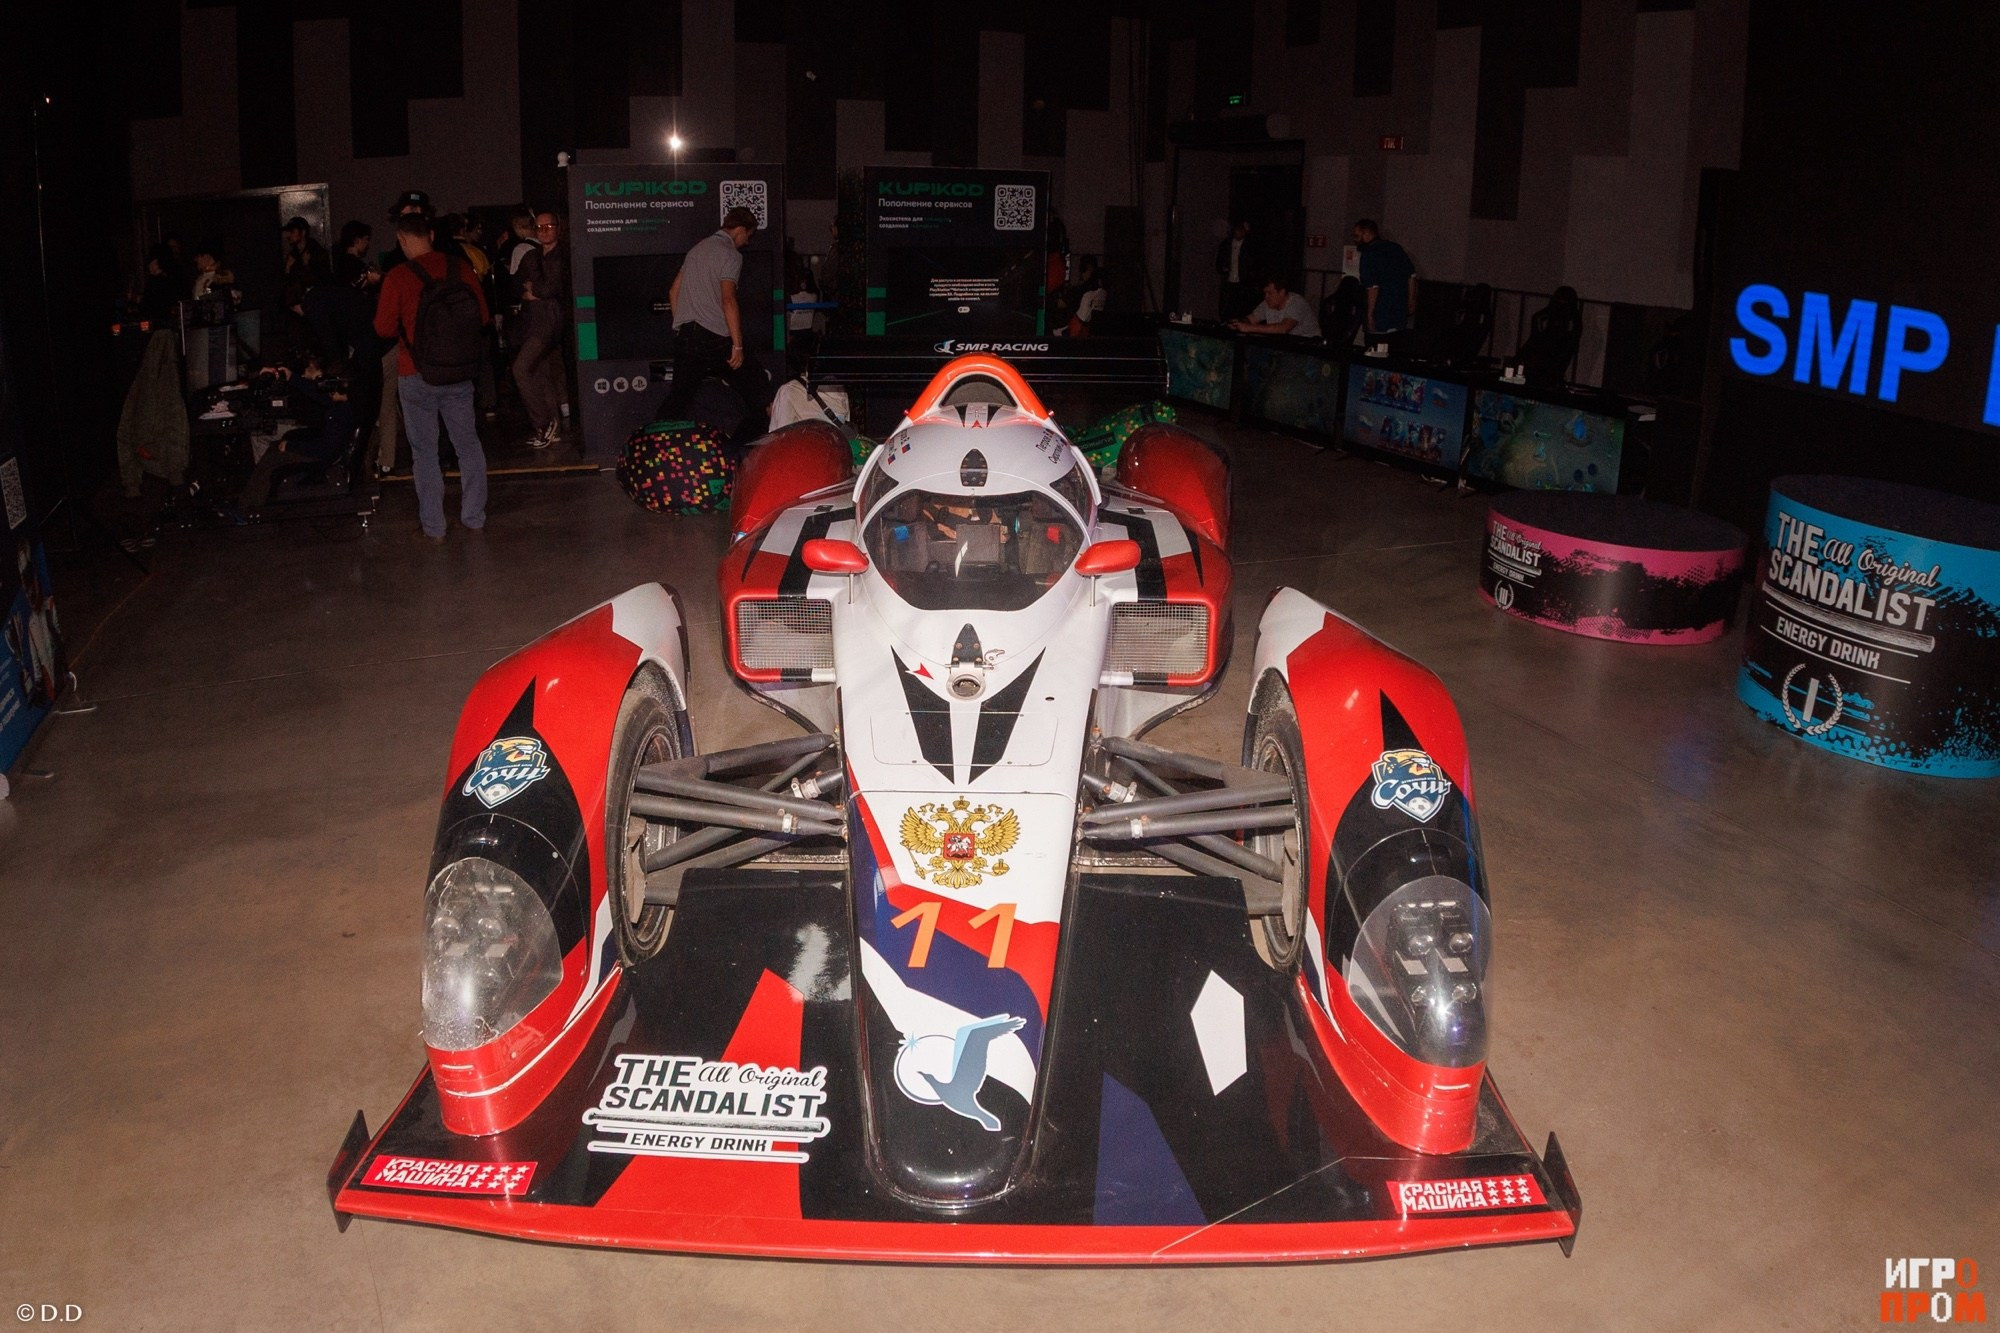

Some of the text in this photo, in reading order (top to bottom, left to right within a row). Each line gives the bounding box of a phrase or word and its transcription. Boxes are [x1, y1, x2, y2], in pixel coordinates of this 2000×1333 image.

[585, 179, 708, 196] KUPIKOD
[878, 181, 985, 197] KUPIKOD
[585, 199, 694, 210] Пополнение сервисов
[878, 198, 973, 209] Пополнение сервисов
[955, 343, 1049, 352] SMP RACING
[1730, 283, 1950, 403] SMP
[1493, 520, 1508, 541] THE
[1490, 535, 1542, 568] SCANDALIST
[1776, 511, 1943, 588] THE All Original
[1768, 552, 1936, 631] SCANDALIST
[1776, 616, 1881, 670] ENERGY DRINK
[463, 766, 551, 795] Сочи
[1374, 779, 1452, 806] Сочи
[620, 1058, 822, 1091] THE All Original
[605, 1086, 821, 1119] SCANDALIST
[630, 1133, 768, 1152] ENERGY DRINK
[385, 1158, 480, 1175] КРАСНАЯ
[375, 1169, 471, 1188] МАШИНА
[1399, 1180, 1484, 1197] КРАСНАЯ
[1401, 1193, 1489, 1211] МАШИНА
